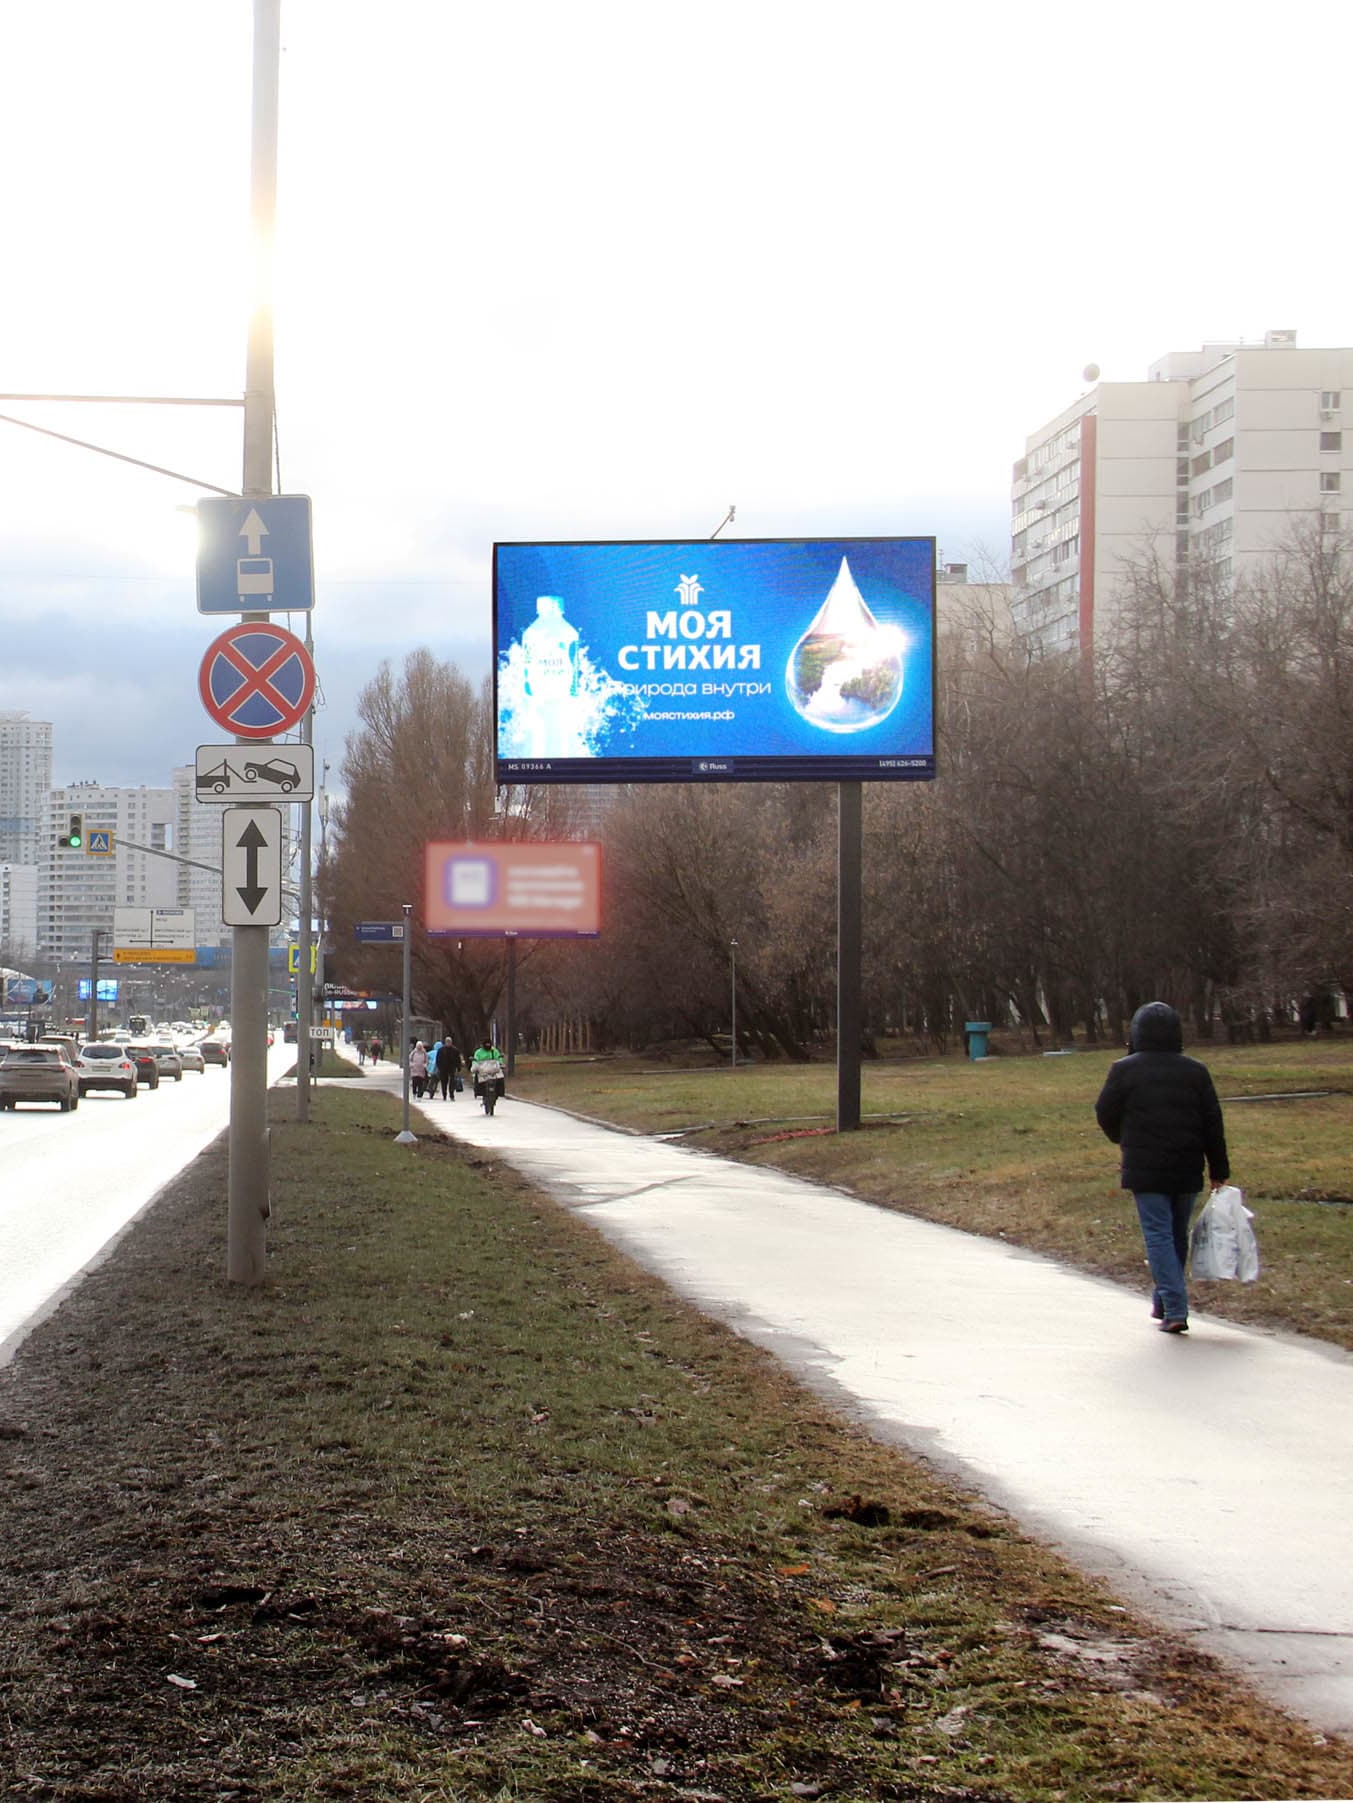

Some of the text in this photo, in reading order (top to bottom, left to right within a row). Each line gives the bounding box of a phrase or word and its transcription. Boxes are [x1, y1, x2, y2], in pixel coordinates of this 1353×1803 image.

[646, 610, 731, 639] МОЯ
[617, 644, 761, 670] СТИХИЯ
[613, 681, 772, 697] рирода внутри
[643, 709, 736, 721] моястихия.рф
